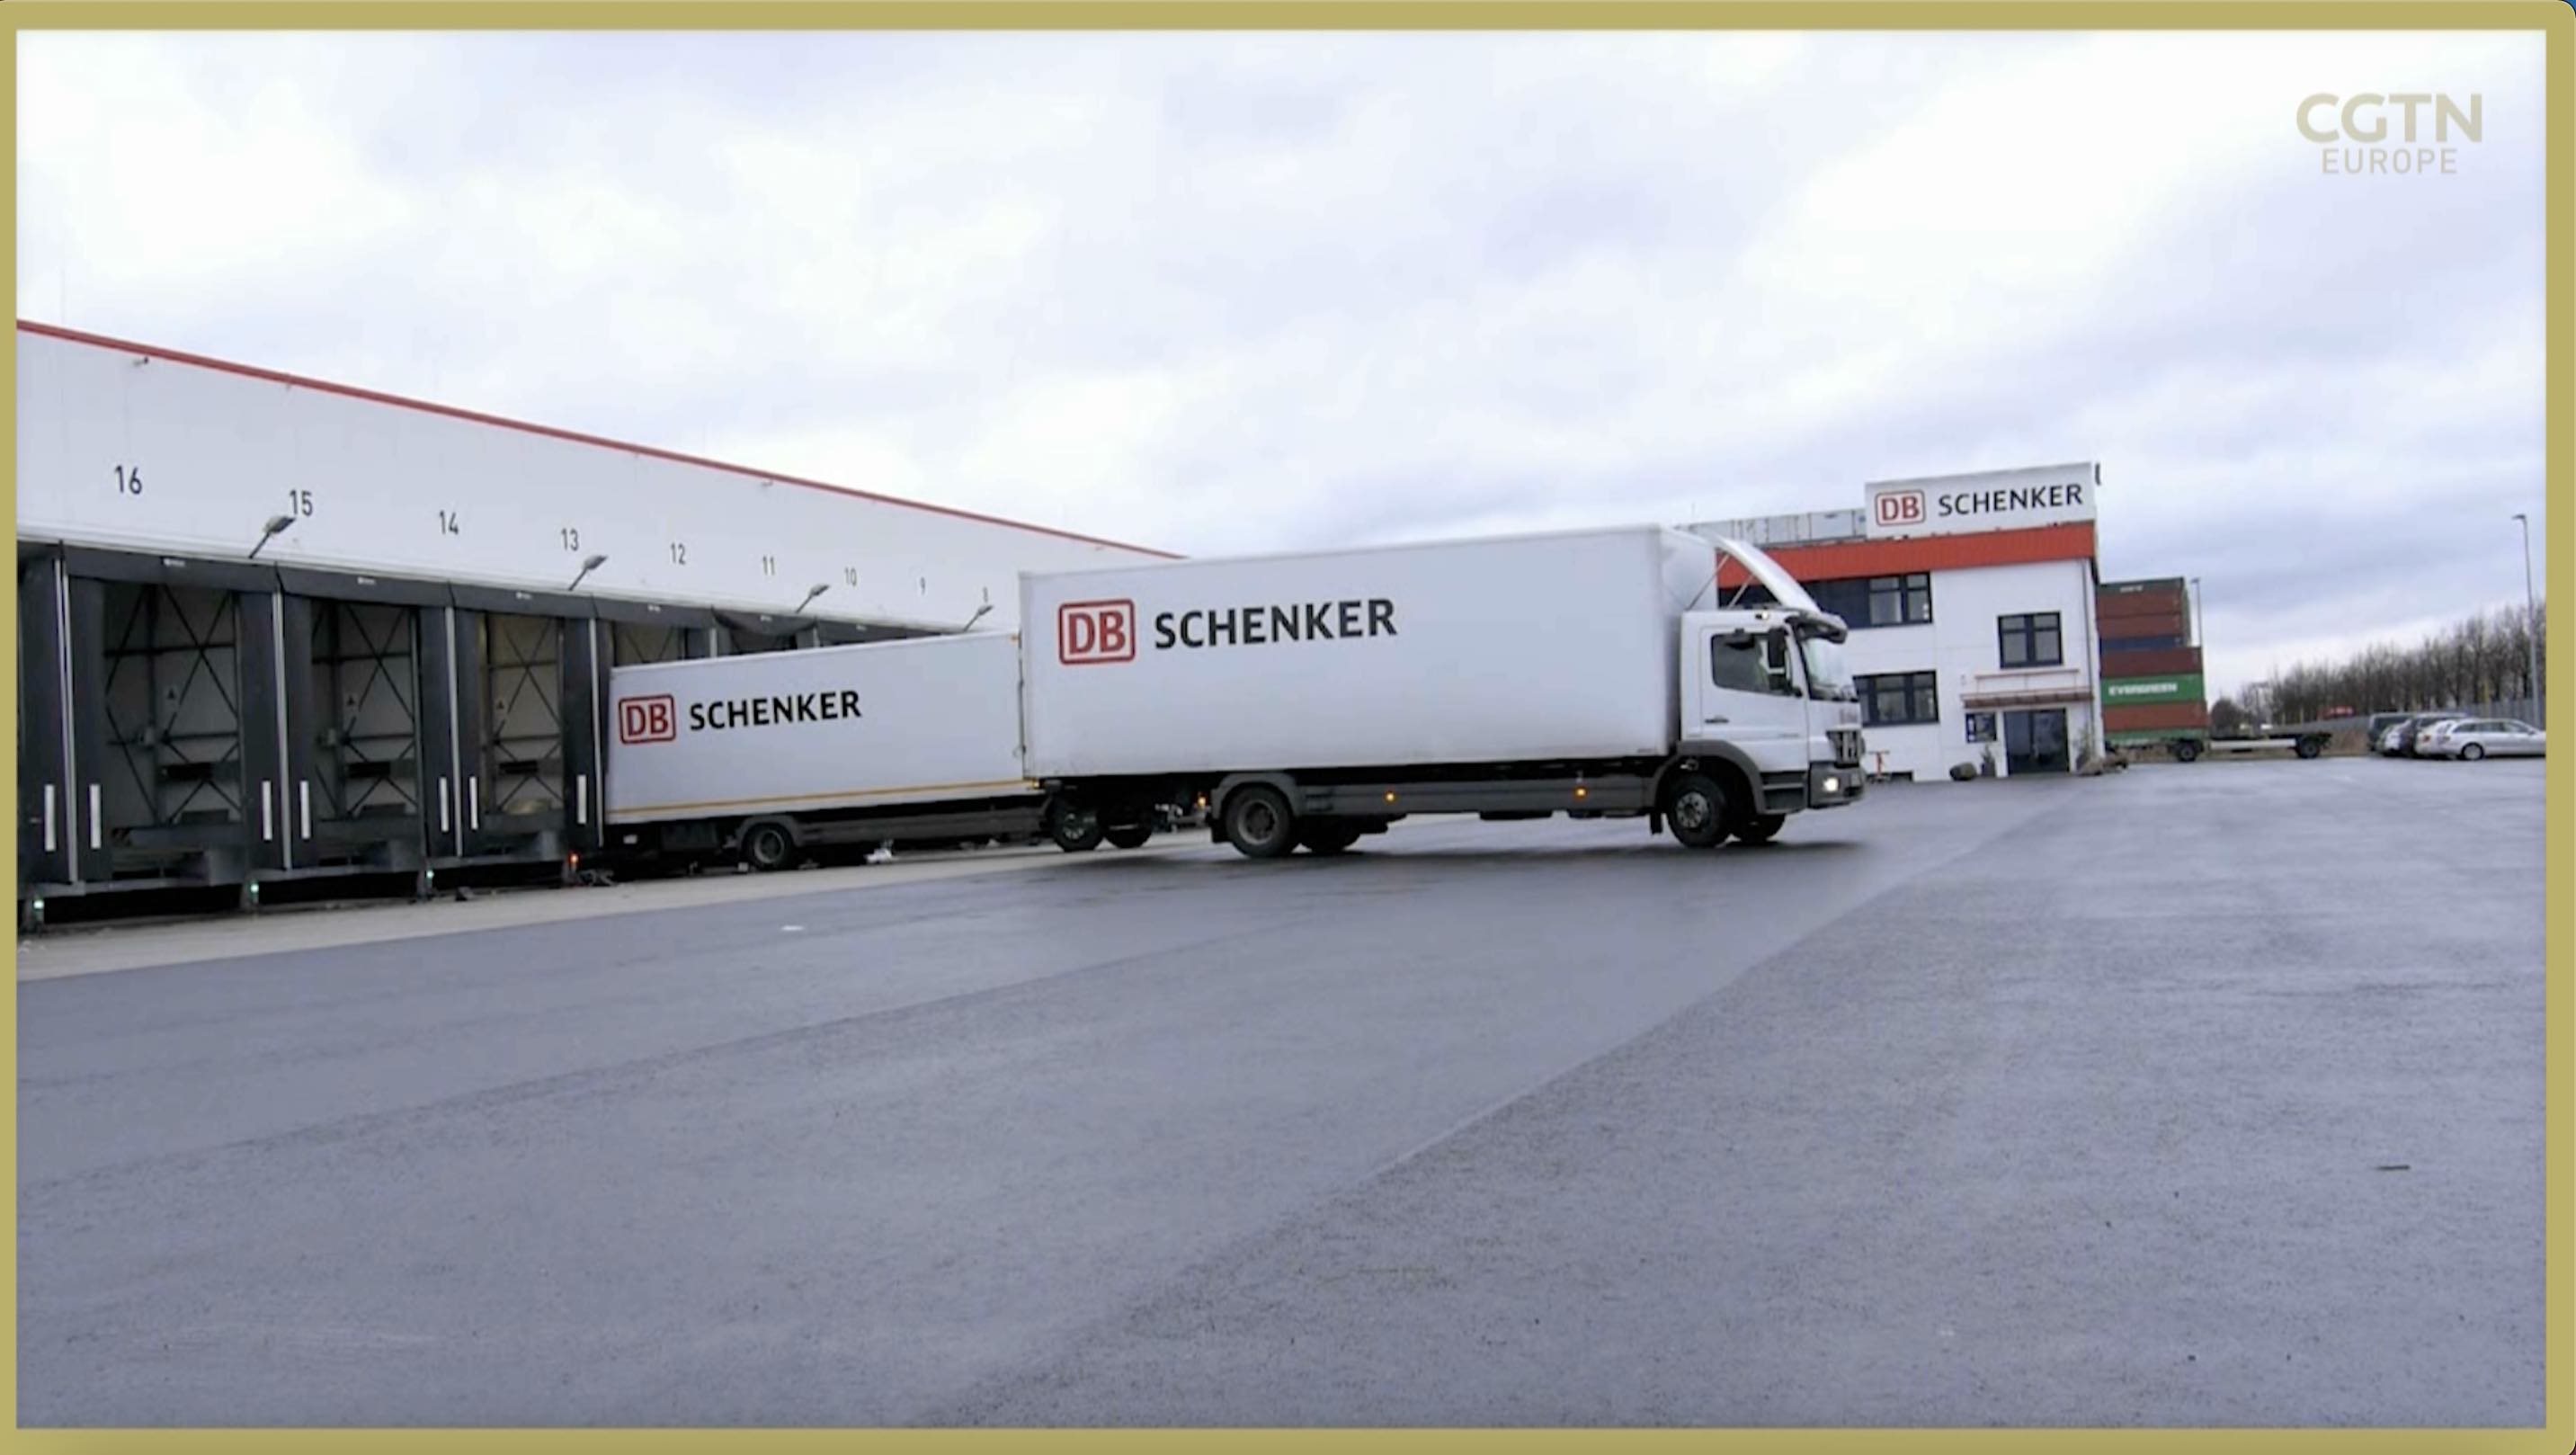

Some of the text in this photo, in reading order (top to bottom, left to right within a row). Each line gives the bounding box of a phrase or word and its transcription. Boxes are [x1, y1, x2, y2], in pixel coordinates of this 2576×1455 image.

[114, 465, 143, 495] 16
[289, 489, 313, 516] 15
[1881, 484, 2083, 521] DB SCHENKER
[439, 510, 459, 535] 14
[560, 528, 580, 552] 13
[670, 542, 686, 566] 12
[762, 555, 776, 576] 11
[844, 567, 858, 587] 10
[1067, 598, 1398, 655] DB SCHENKER
[625, 690, 862, 737] DB SCHENKER
